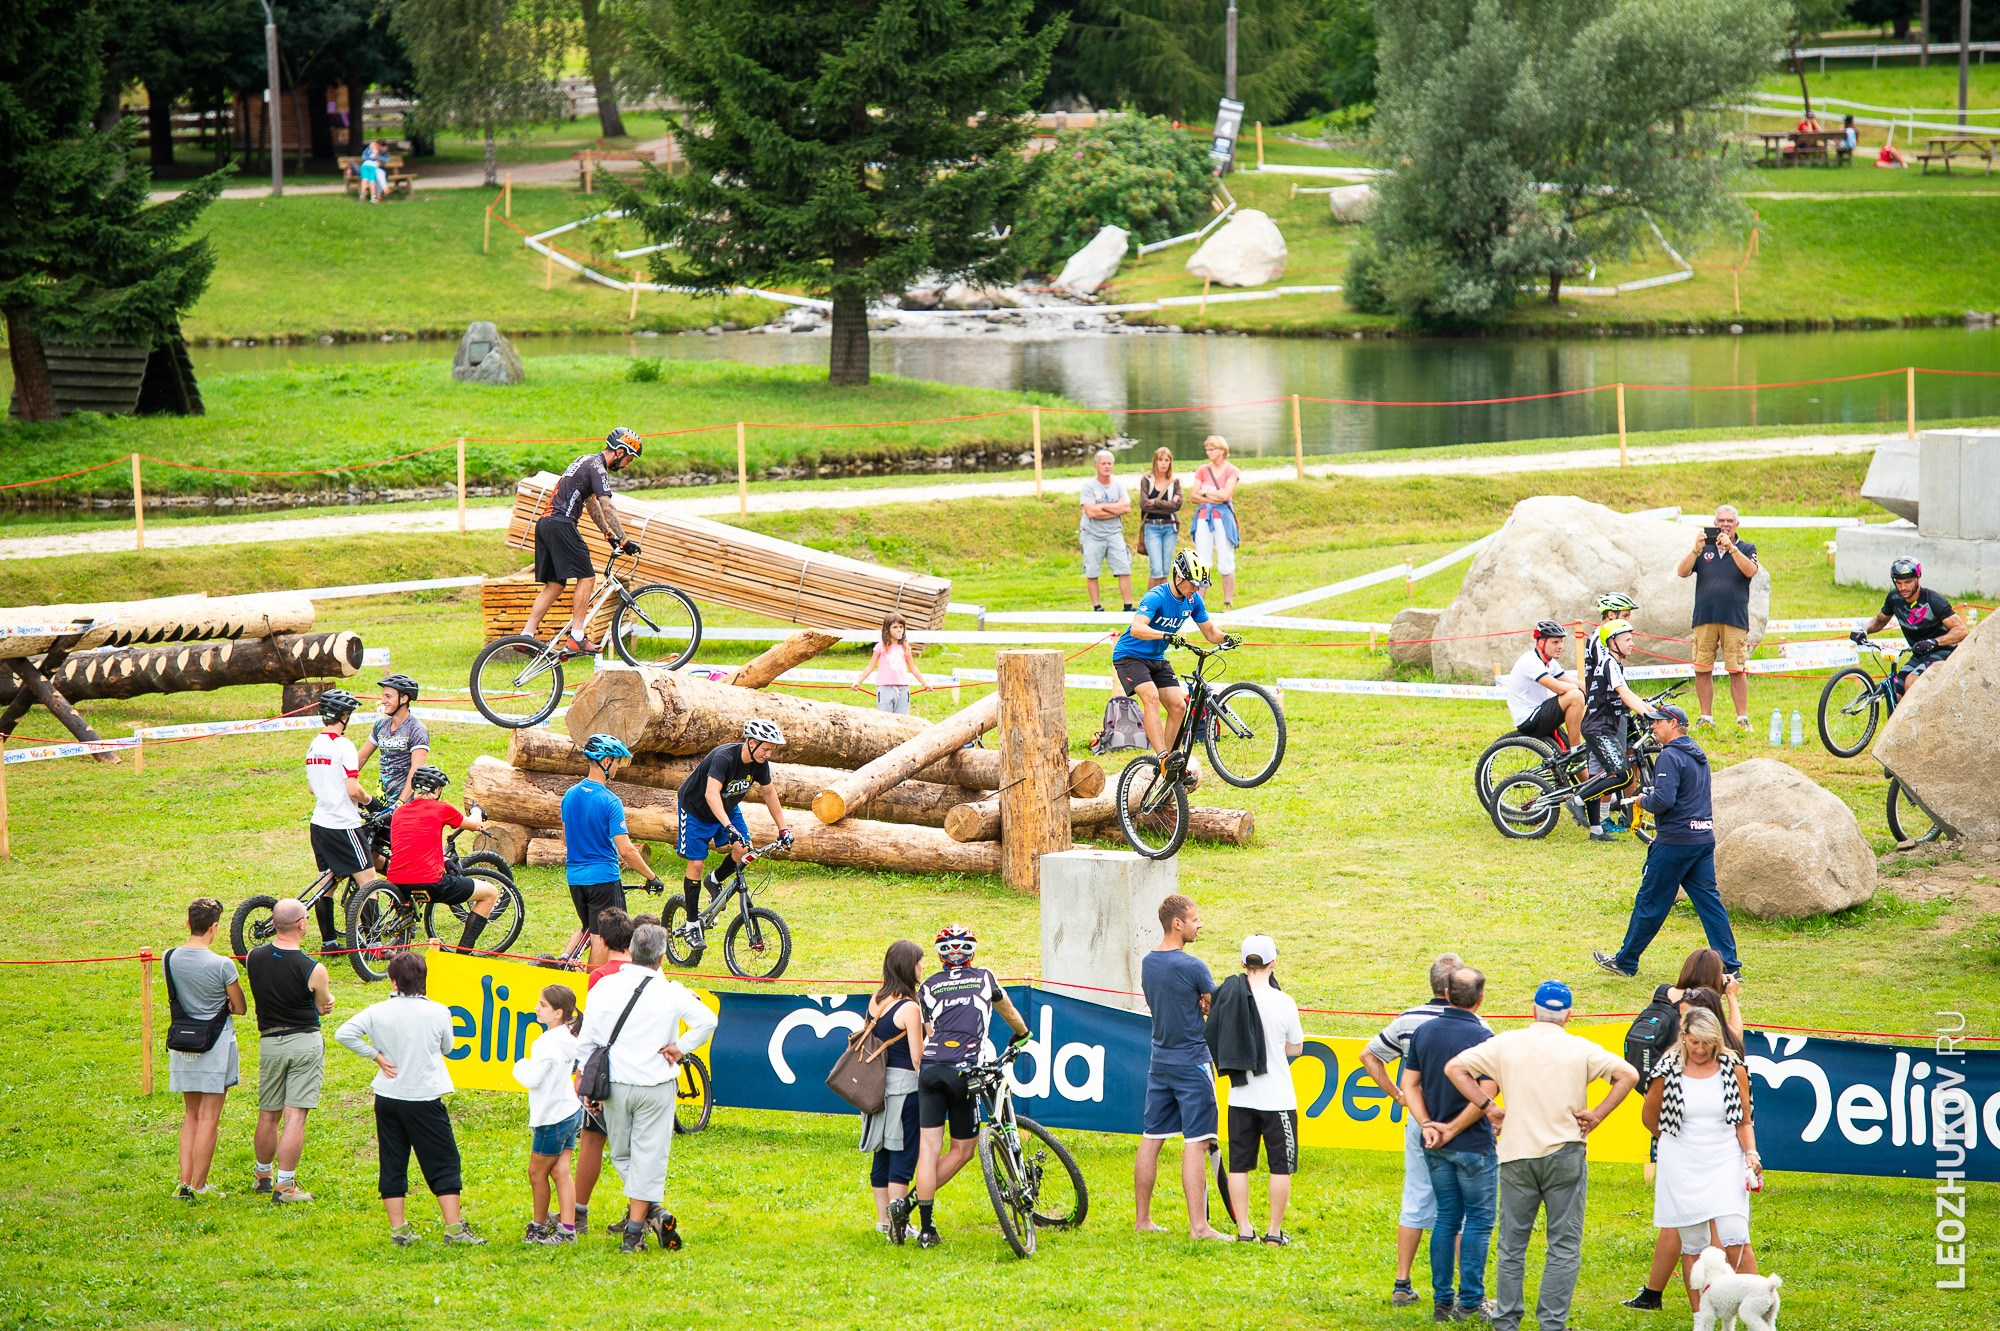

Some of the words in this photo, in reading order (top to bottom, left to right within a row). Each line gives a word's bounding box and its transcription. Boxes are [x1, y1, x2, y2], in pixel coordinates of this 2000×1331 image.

[1155, 616, 1184, 629] ITALI
[933, 986, 958, 995] FACTORY
[959, 983, 981, 992] RACING
